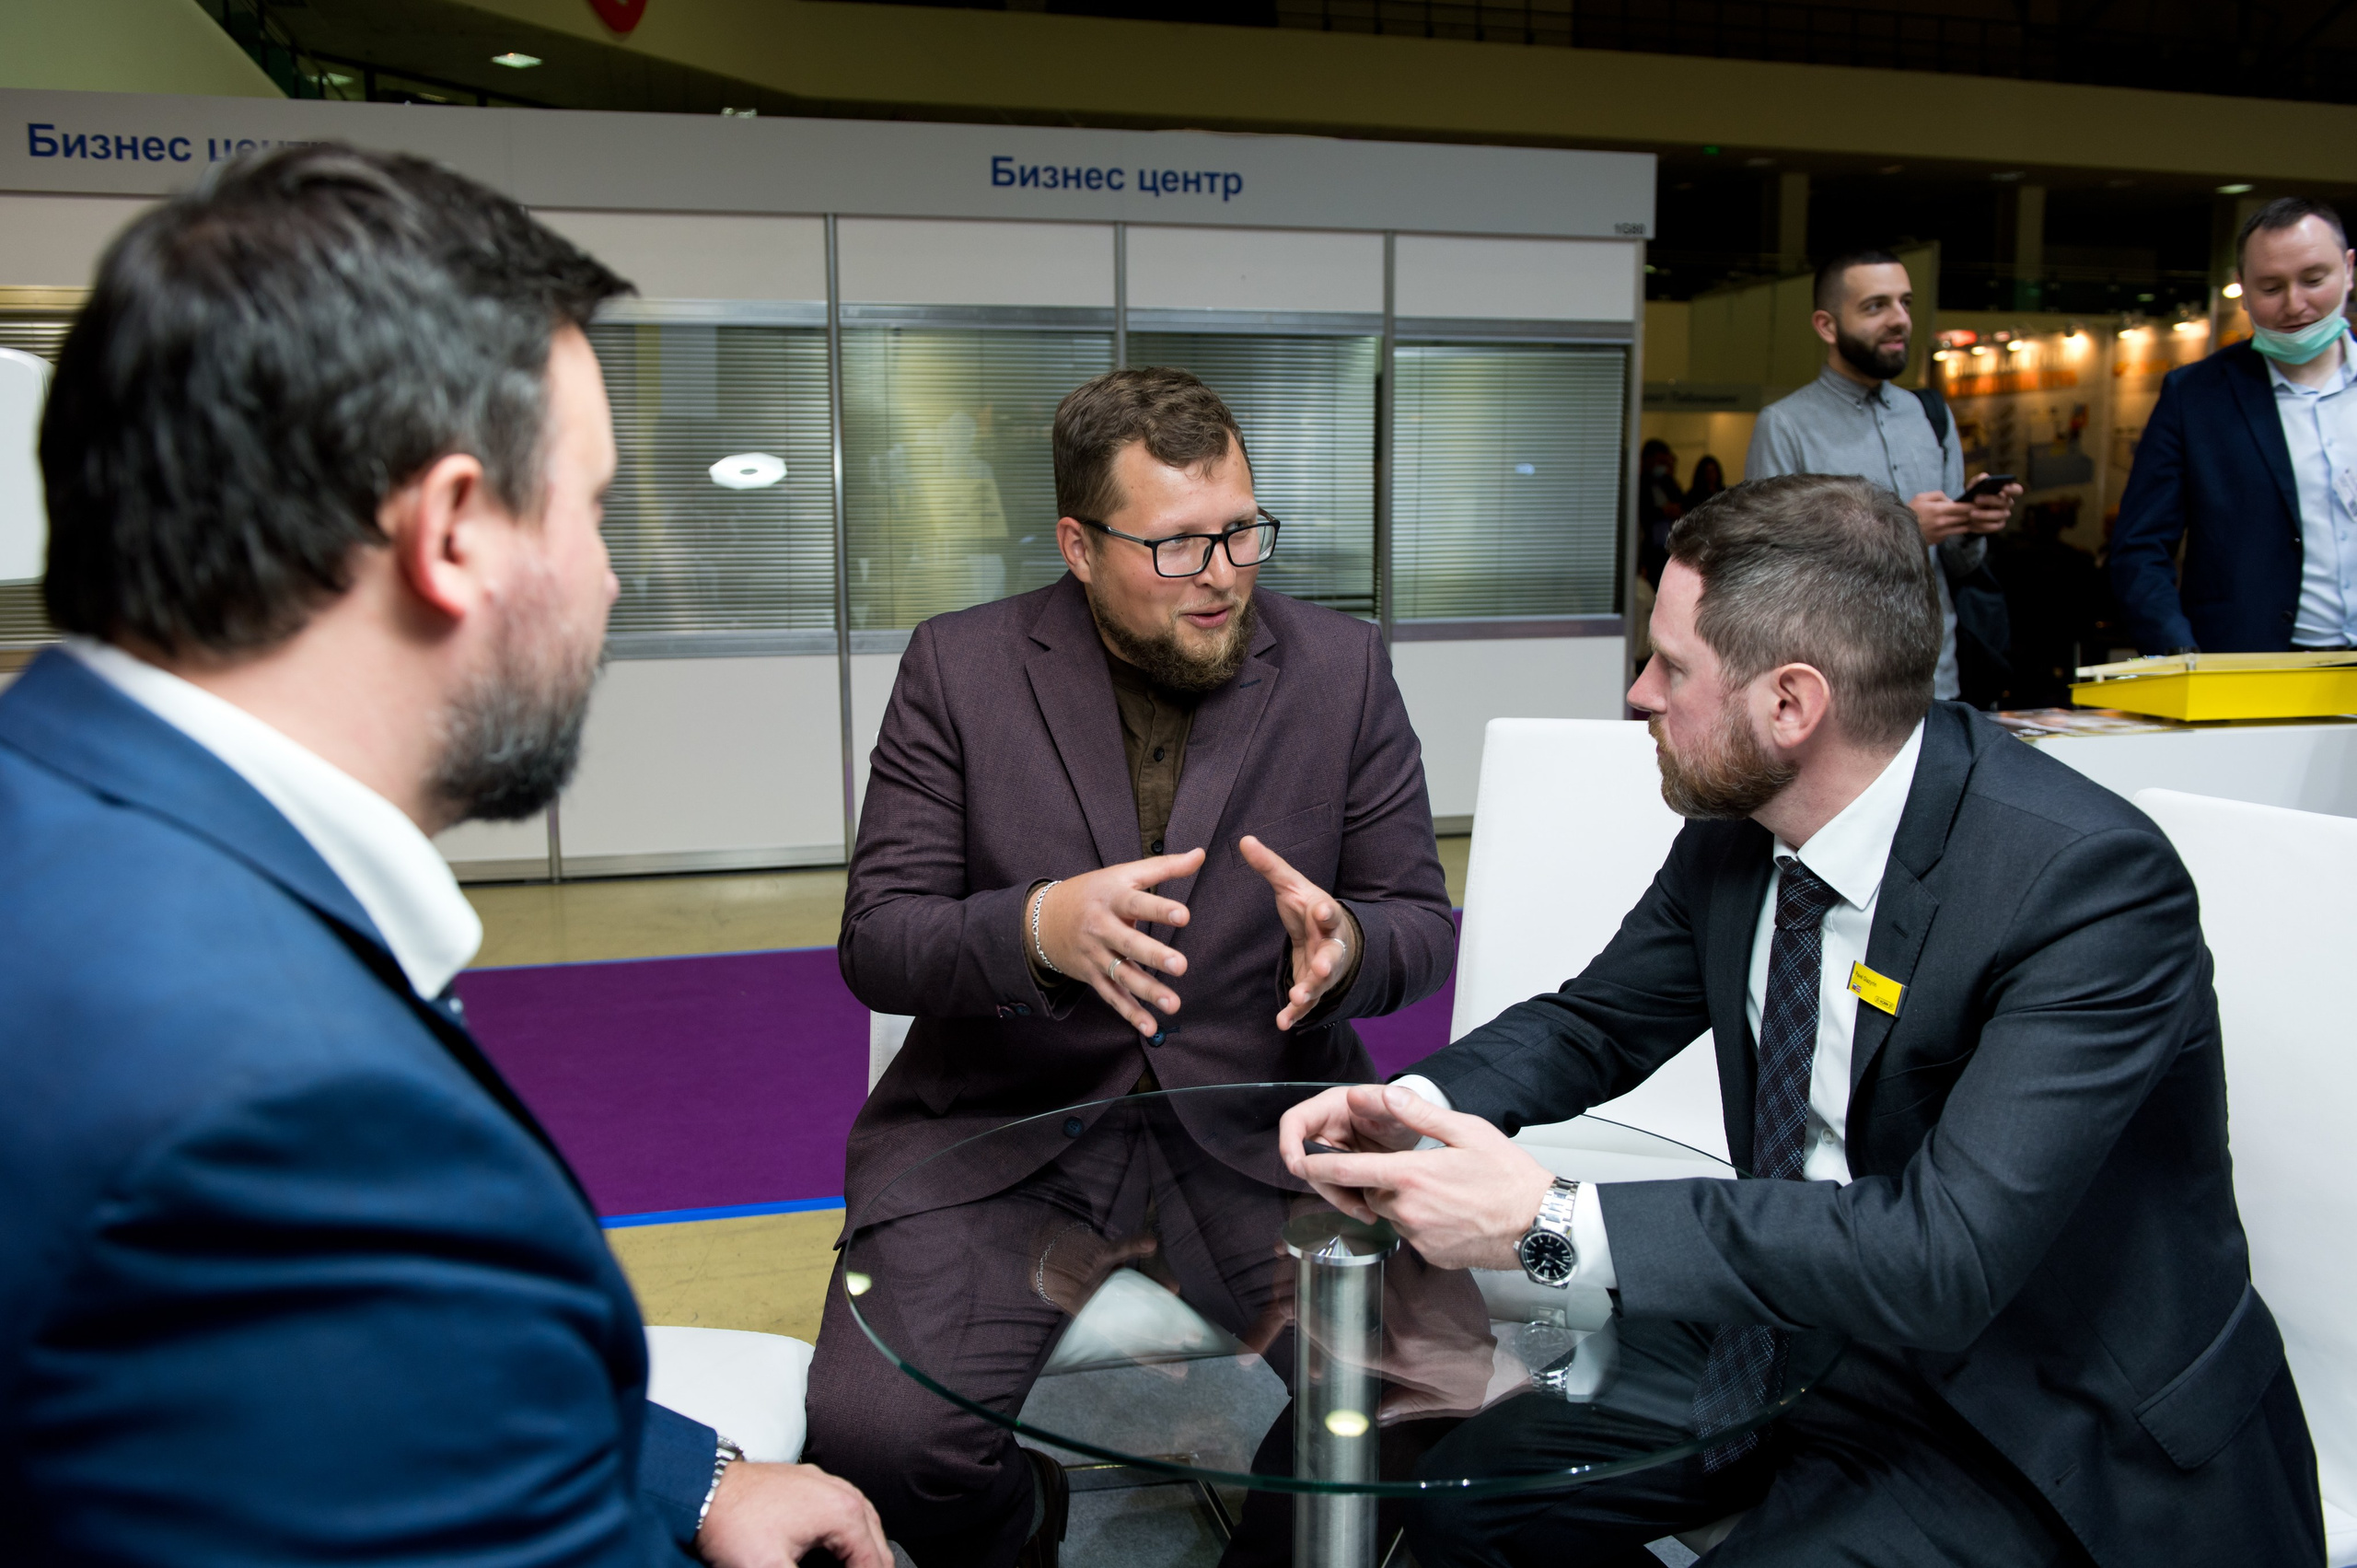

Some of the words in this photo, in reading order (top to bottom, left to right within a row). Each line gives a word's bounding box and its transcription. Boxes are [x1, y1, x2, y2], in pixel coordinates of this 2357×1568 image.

[28, 122, 192, 162] Бизнес
[991, 156, 1125, 191] Бизнес
[1138, 168, 1243, 202] центр
